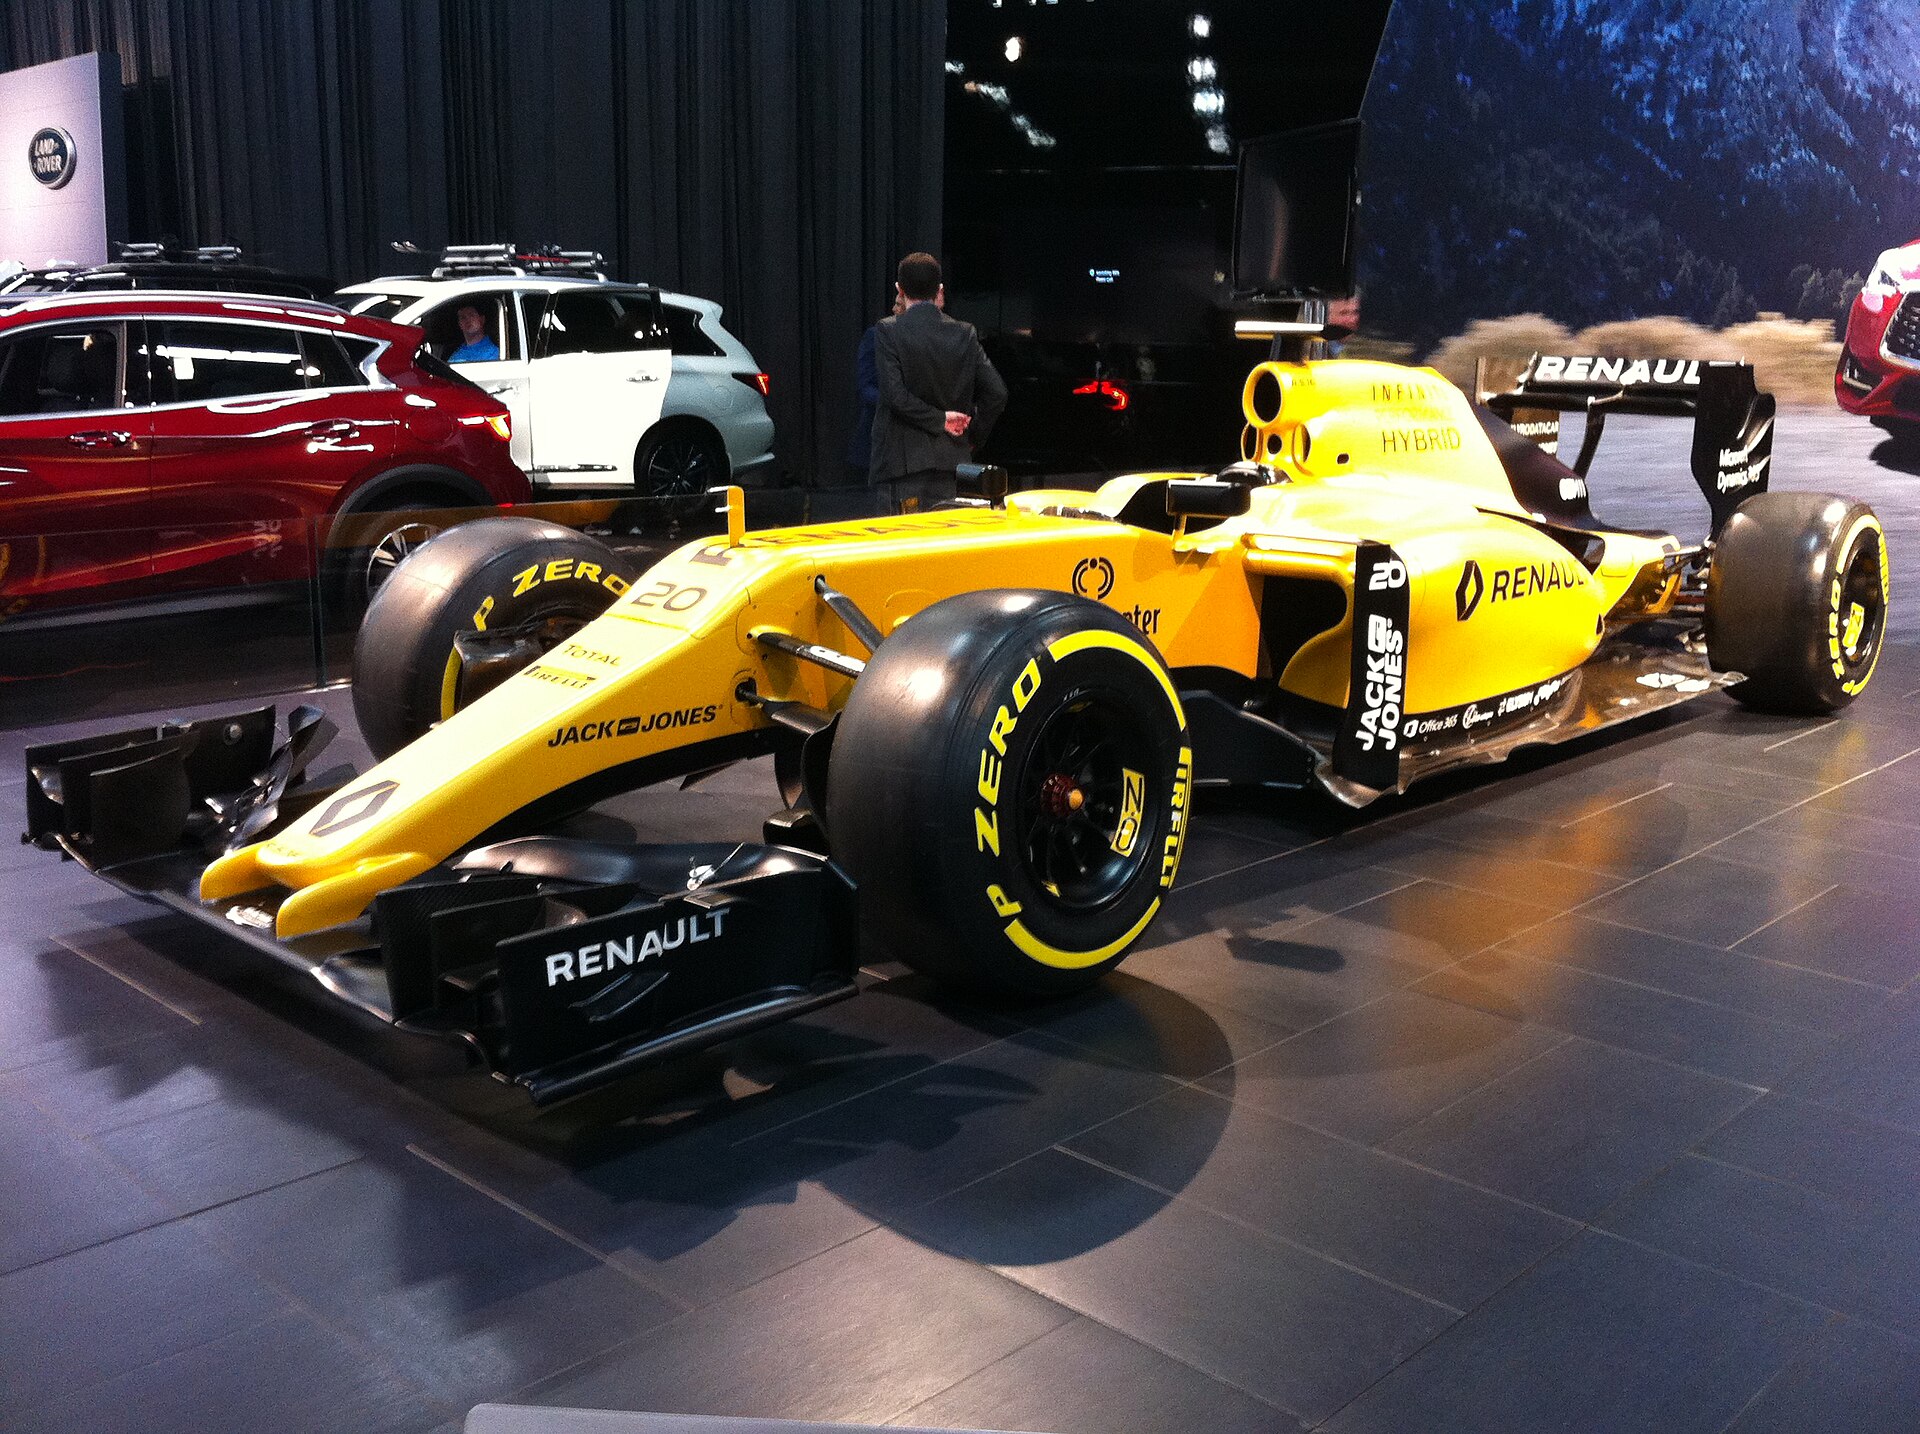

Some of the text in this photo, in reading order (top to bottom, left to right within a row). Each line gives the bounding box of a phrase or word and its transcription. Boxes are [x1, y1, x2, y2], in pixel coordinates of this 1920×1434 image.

[34, 138, 55, 156] LAND
[36, 154, 62, 173] ROVER
[1535, 356, 1701, 385] RENAUL
[1382, 427, 1461, 453] HYBRID
[512, 559, 632, 598] ZERO
[1368, 560, 1407, 591] 20
[1491, 561, 1585, 604] RENAUL
[631, 582, 708, 612] 20
[562, 644, 621, 667] TOTAL
[1355, 653, 1386, 751] JACK
[1378, 628, 1404, 751] JONES
[548, 704, 718, 748] JACK JONES
[1418, 718, 1443, 735] Office
[974, 657, 1042, 917] P ZERO
[545, 907, 731, 987] RENAULT
